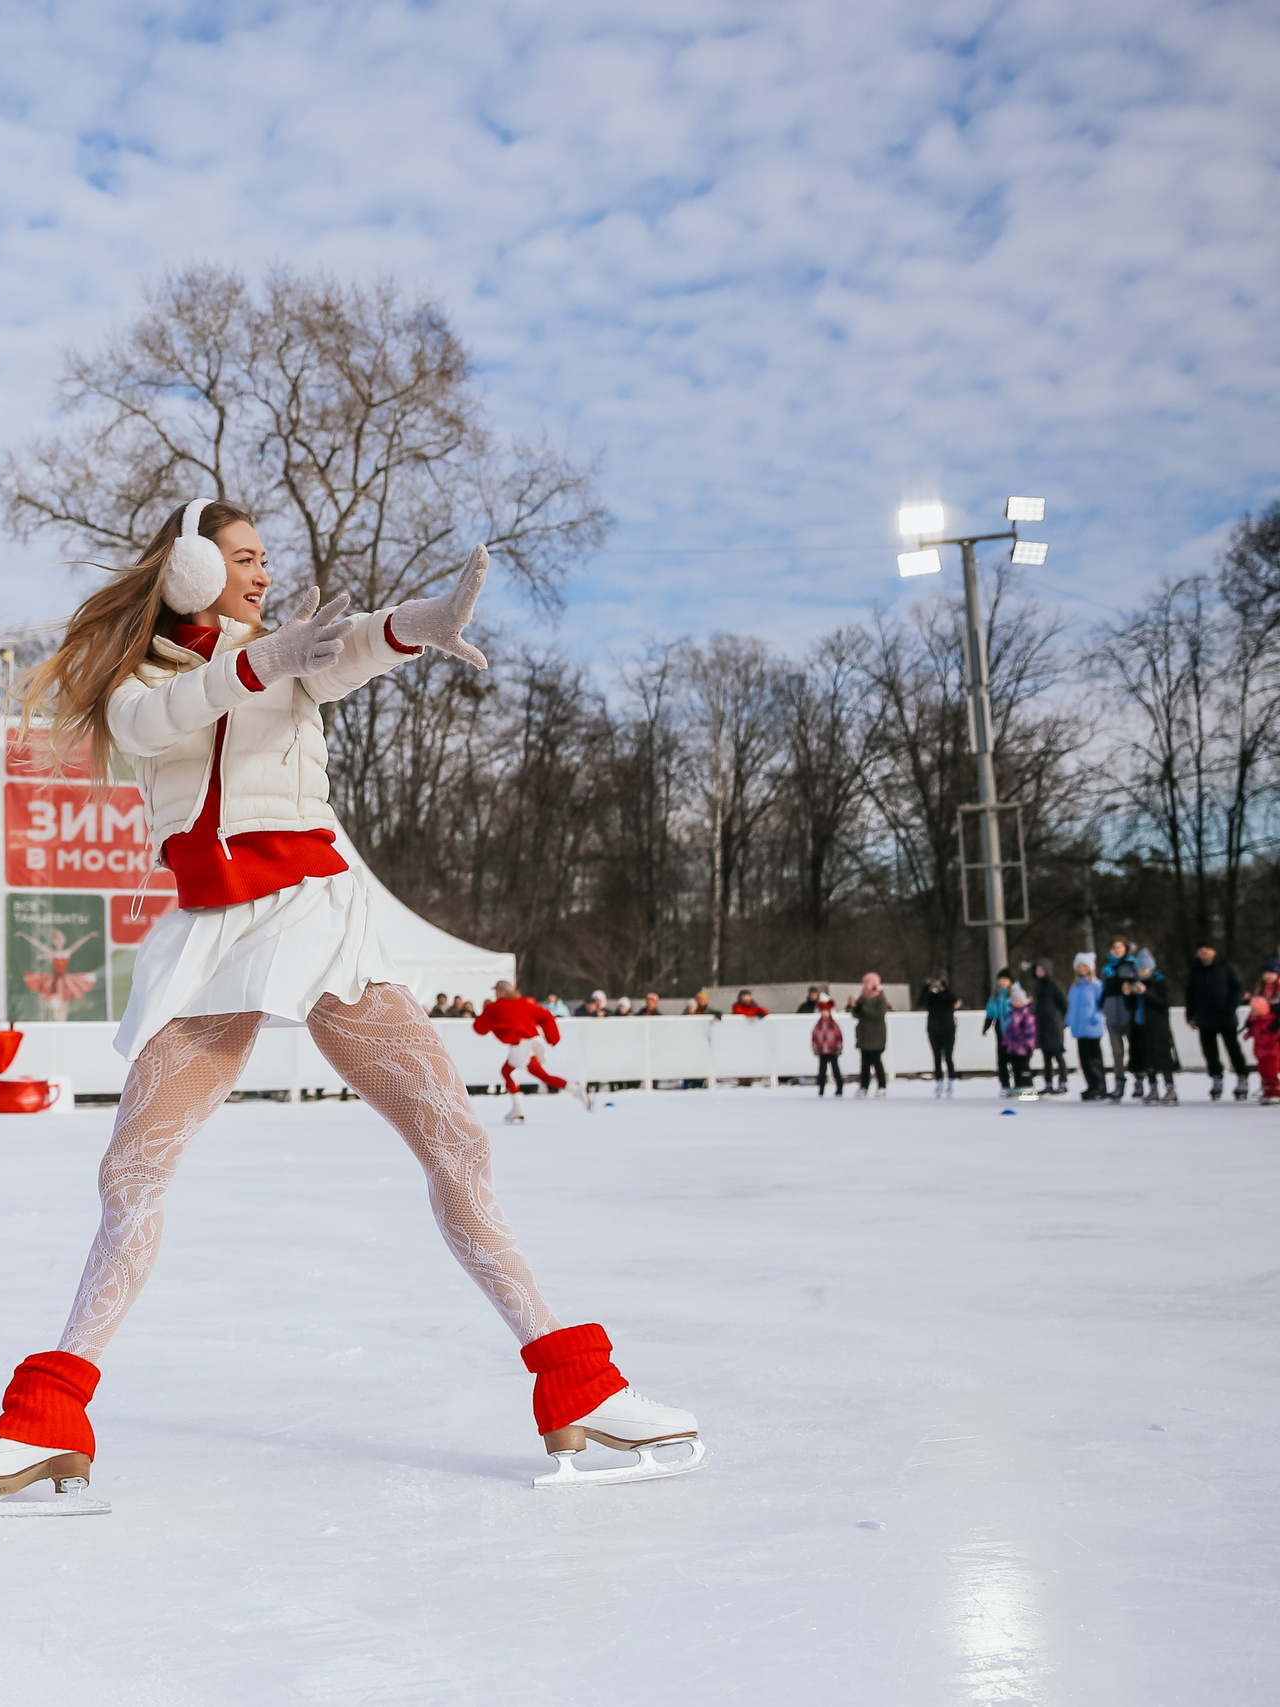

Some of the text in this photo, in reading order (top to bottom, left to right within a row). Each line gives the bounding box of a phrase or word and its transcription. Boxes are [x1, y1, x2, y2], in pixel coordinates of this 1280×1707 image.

[26, 801, 145, 844] ЗИМ
[26, 848, 156, 872] В МОСК
